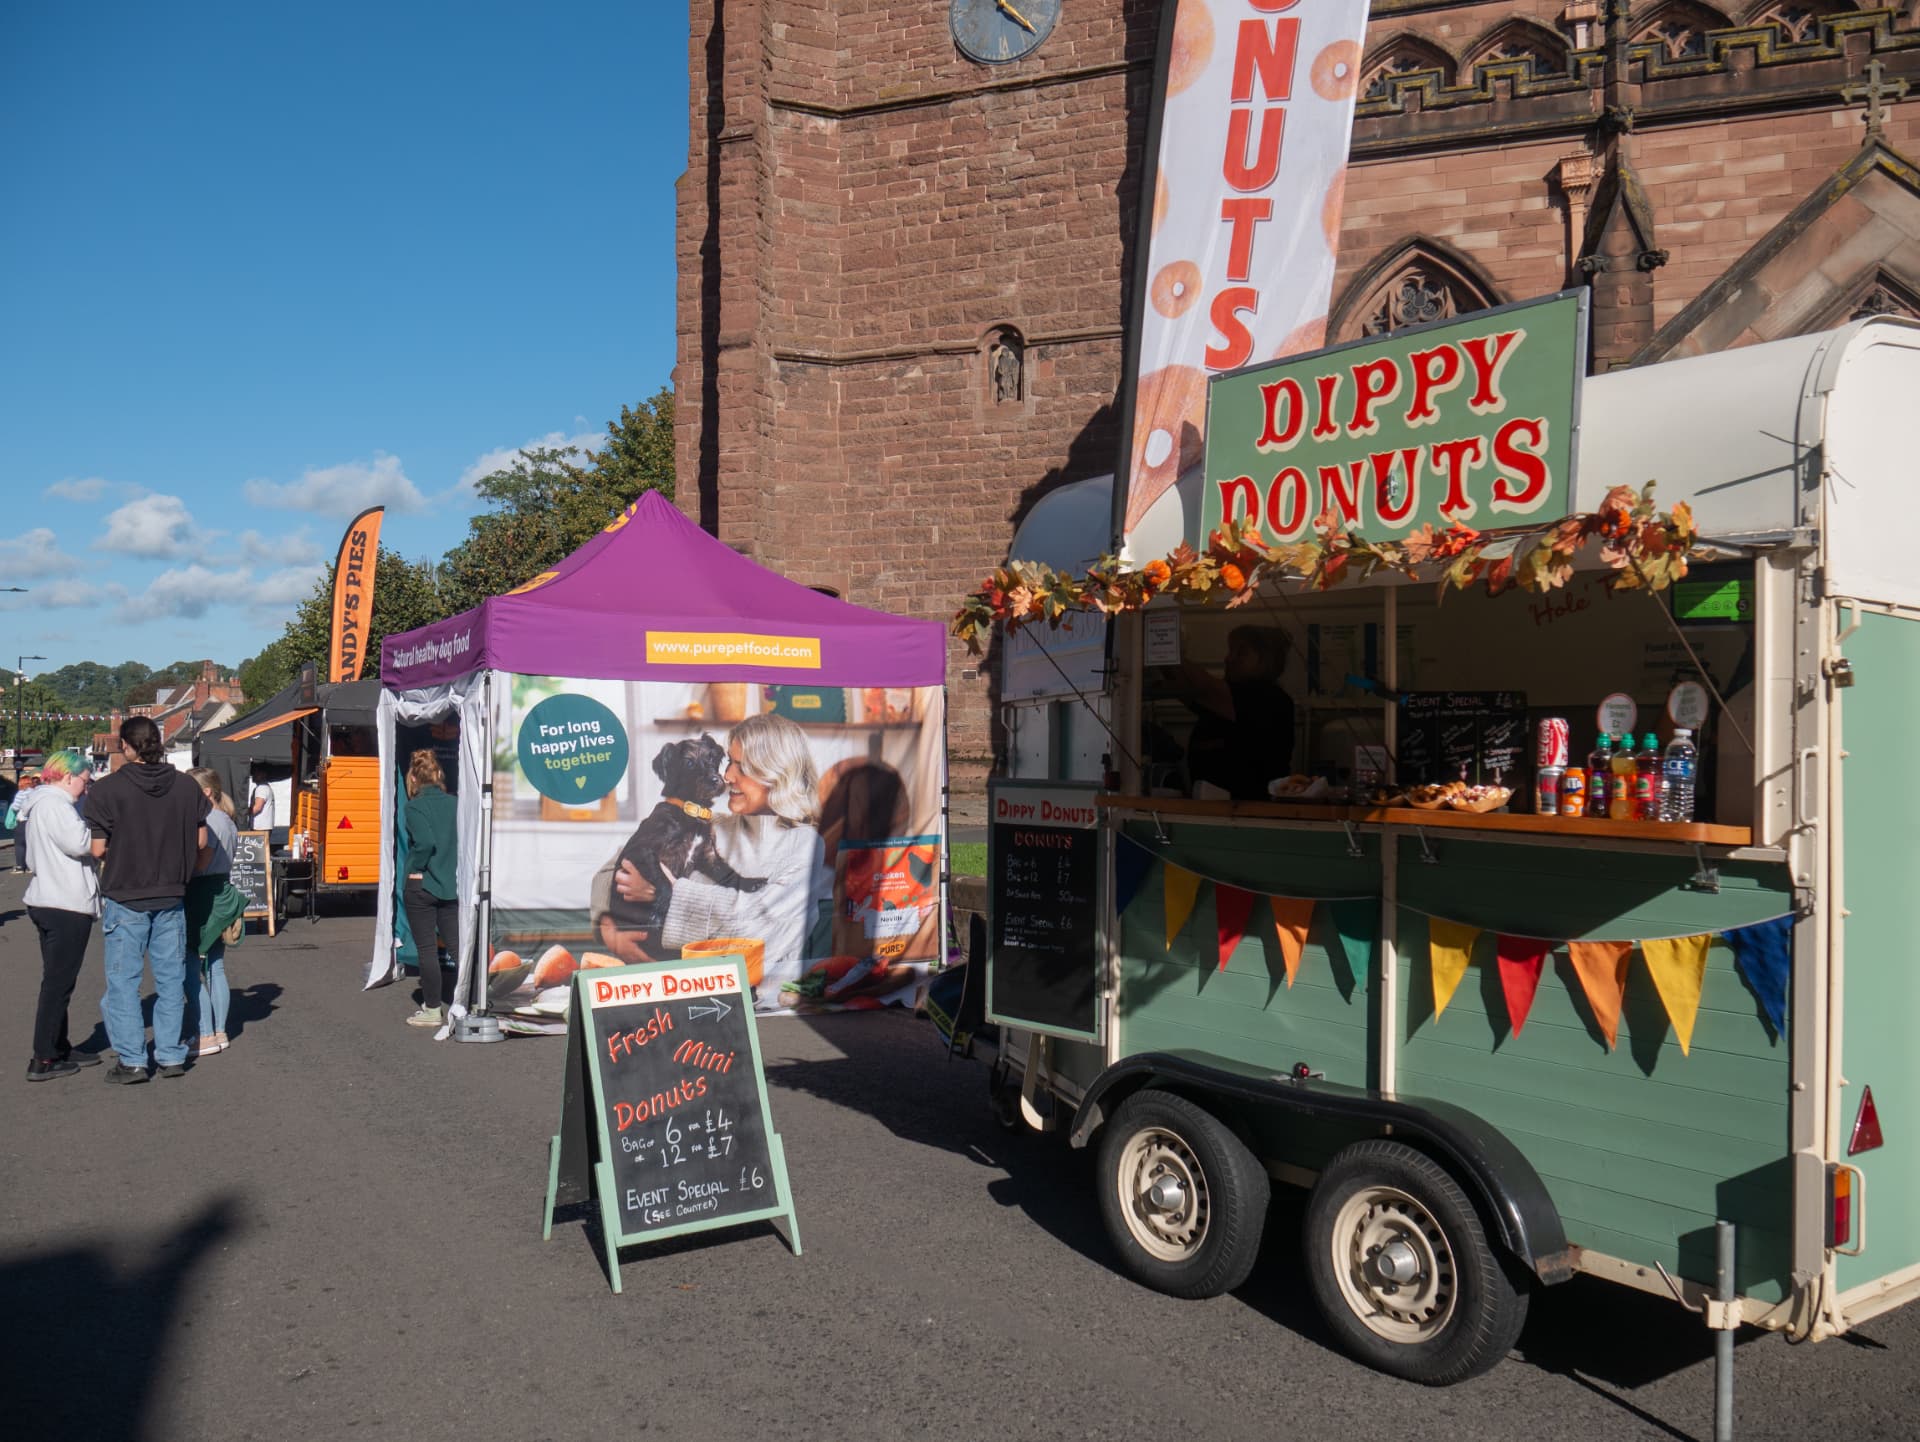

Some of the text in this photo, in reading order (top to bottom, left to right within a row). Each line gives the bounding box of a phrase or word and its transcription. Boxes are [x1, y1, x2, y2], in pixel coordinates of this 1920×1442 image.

[1204, 0, 1302, 372] NUTS
[1256, 328, 1527, 455] DIPPY
[1217, 417, 1553, 543] DONUTS
[346, 530, 368, 587] PIES
[392, 628, 471, 669] Natural healthy dog food
[653, 640, 813, 658] www.purepetfood.com
[530, 734, 615, 755] happy lives
[539, 720, 601, 737] For long
[544, 751, 612, 772] together
[997, 798, 1095, 824] DIPPY DONUTS
[595, 972, 736, 1004] DIPPY DONUTS
[607, 1006, 674, 1064] Fresh
[672, 1038, 735, 1074] Mini
[612, 1075, 708, 1132] Donuts
[665, 1115, 682, 1146] 6
[705, 1108, 733, 1134] £4
[660, 1144, 687, 1169] 12
[706, 1135, 733, 1160] £7
[626, 1166, 765, 1211] EVENT SPECIAL £6
